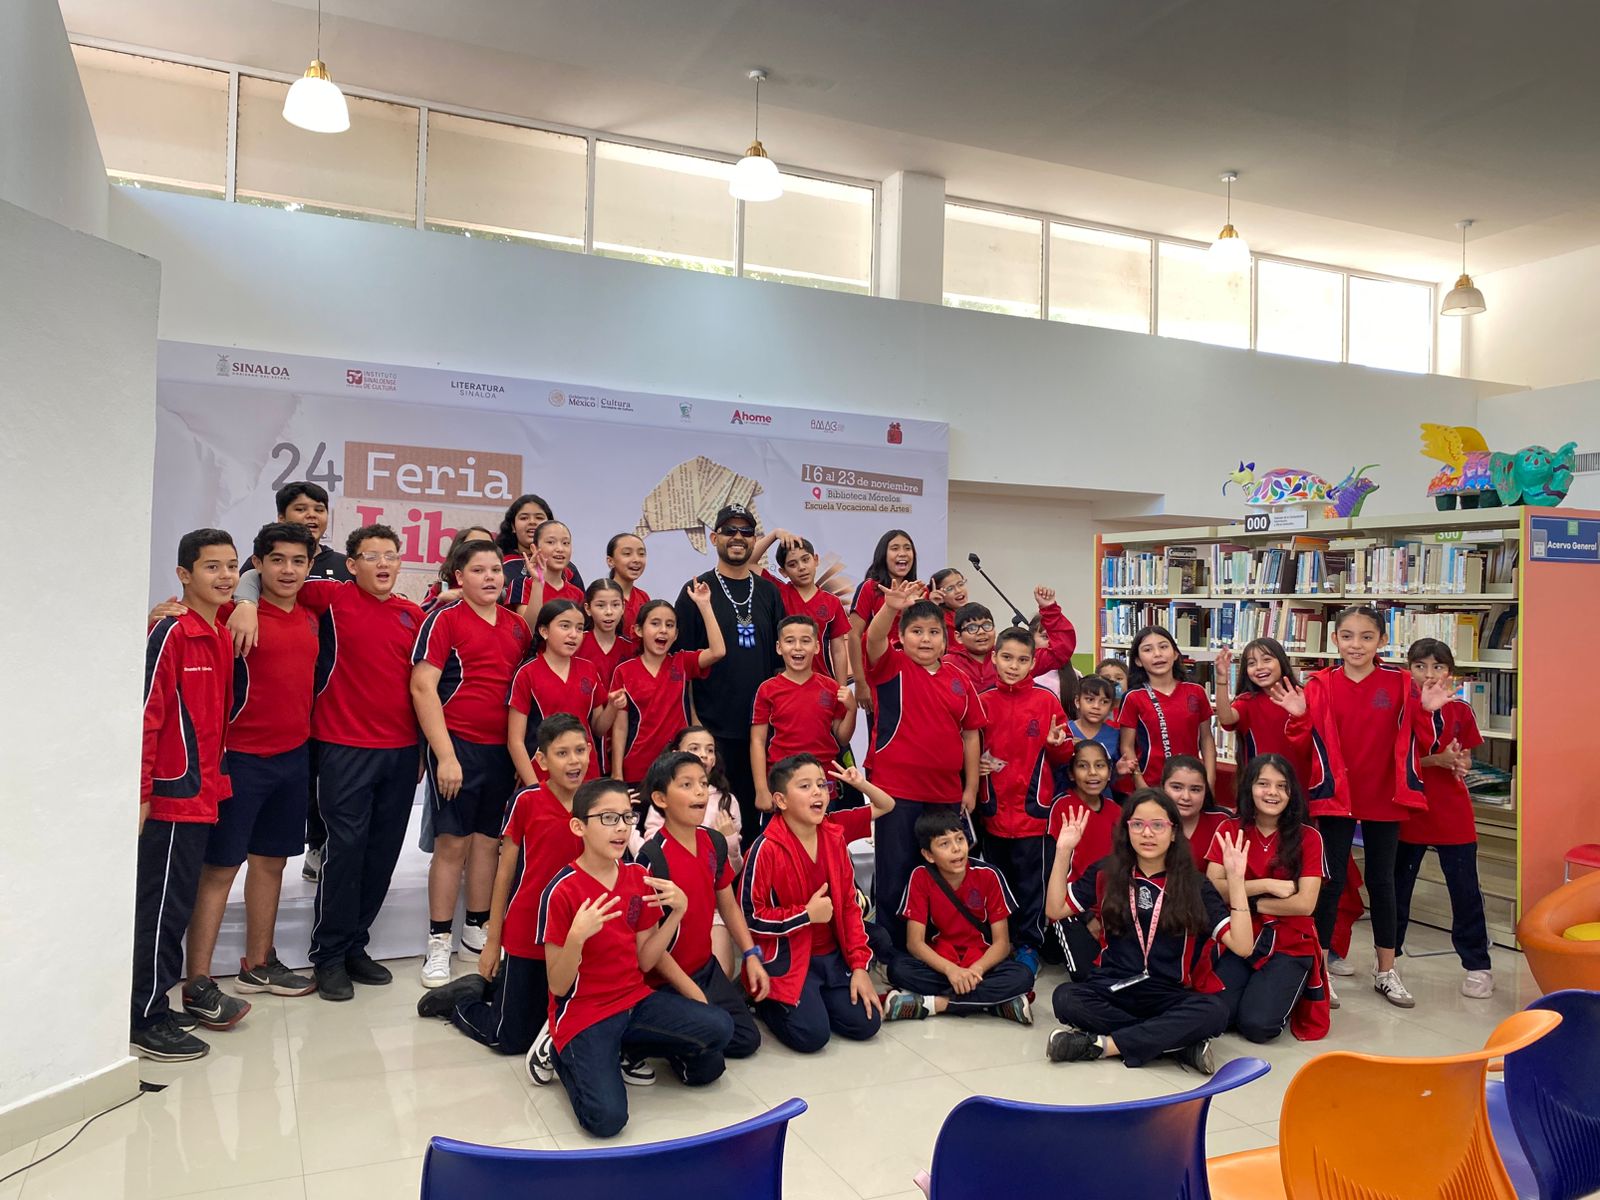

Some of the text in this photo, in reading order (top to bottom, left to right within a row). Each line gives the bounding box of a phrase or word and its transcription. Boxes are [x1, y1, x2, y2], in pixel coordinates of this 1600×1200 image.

[232, 362, 290, 377] SINALOA
[364, 370, 398, 380] INSTITUTO
[364, 377, 397, 386] SINALOENSE
[451, 380, 505, 393] LITERATURA
[460, 389, 497, 399] SINALOA
[568, 398, 596, 408] México
[600, 398, 631, 408] Cultura
[730, 409, 772, 425] Ahome
[272, 442, 512, 500] 24 Feria
[804, 465, 919, 493] 16 al 23 de noviembre
[828, 489, 900, 503] Biblioteca Morelos
[804, 501, 910, 513] Escuela Vocacional de Artes
[1247, 516, 1267, 530] 000
[1547, 540, 1571, 549] Acervo
[1572, 541, 1597, 550] General
